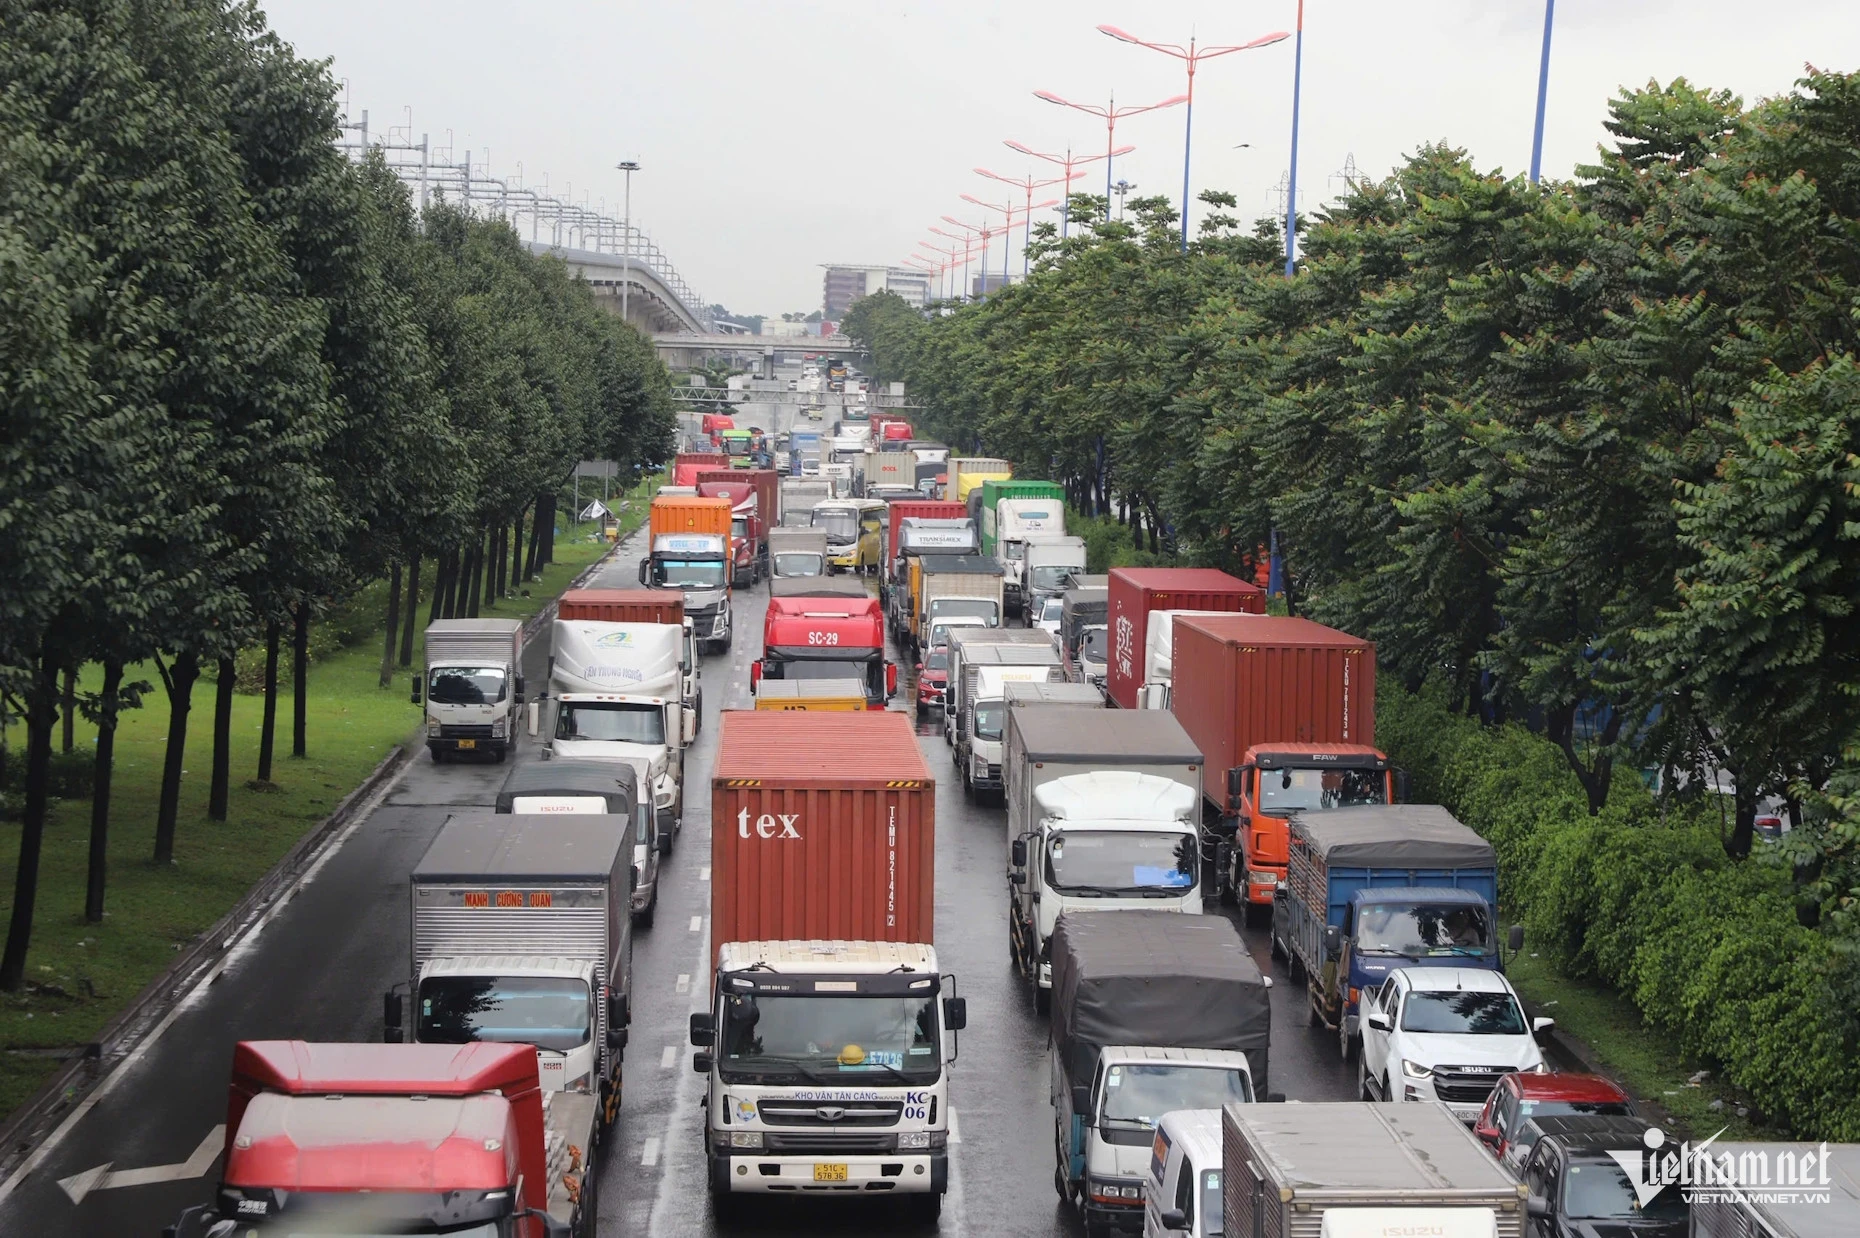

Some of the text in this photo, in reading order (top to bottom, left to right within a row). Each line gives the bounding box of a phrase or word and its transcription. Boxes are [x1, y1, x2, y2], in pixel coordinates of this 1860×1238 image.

[808, 631, 838, 646] SC-29
[737, 806, 801, 839] tex
[795, 1092, 812, 1100] KHO
[906, 1092, 928, 1104] KC
[905, 1107, 925, 1119] 06
[817, 1172, 844, 1180] 578.36
[1382, 1227, 1443, 1237] ISUZU
